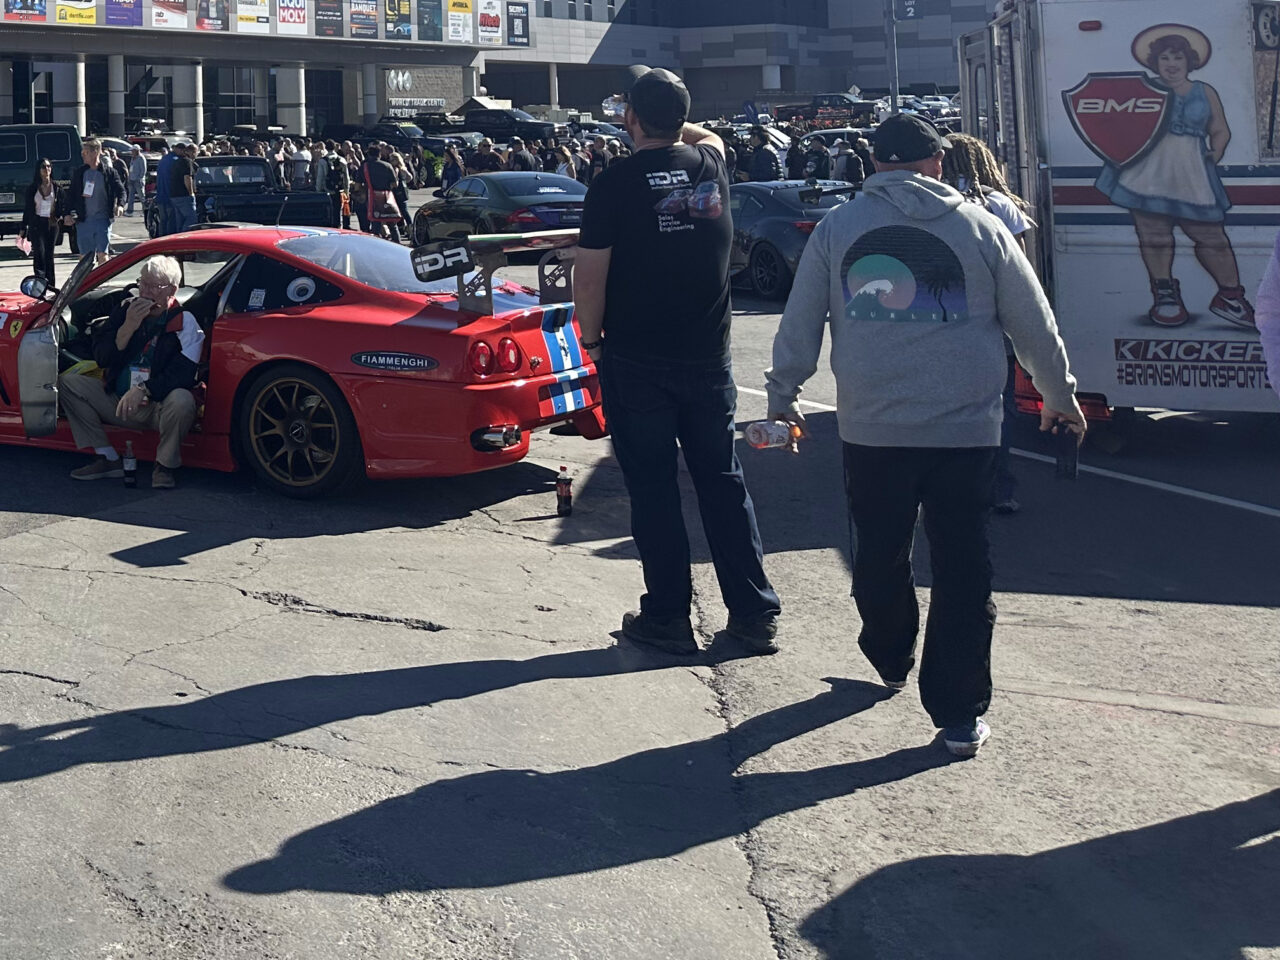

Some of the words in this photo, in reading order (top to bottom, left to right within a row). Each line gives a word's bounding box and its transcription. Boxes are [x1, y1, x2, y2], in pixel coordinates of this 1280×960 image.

[280, 8, 305, 23] MOLY
[906, 7, 915, 17] 2
[390, 98, 410, 106] WORLD
[427, 98, 445, 106] CENTER
[1076, 98, 1163, 113] BMS
[659, 223, 695, 232] Engineering
[361, 355, 428, 367] FIAMMENGHI
